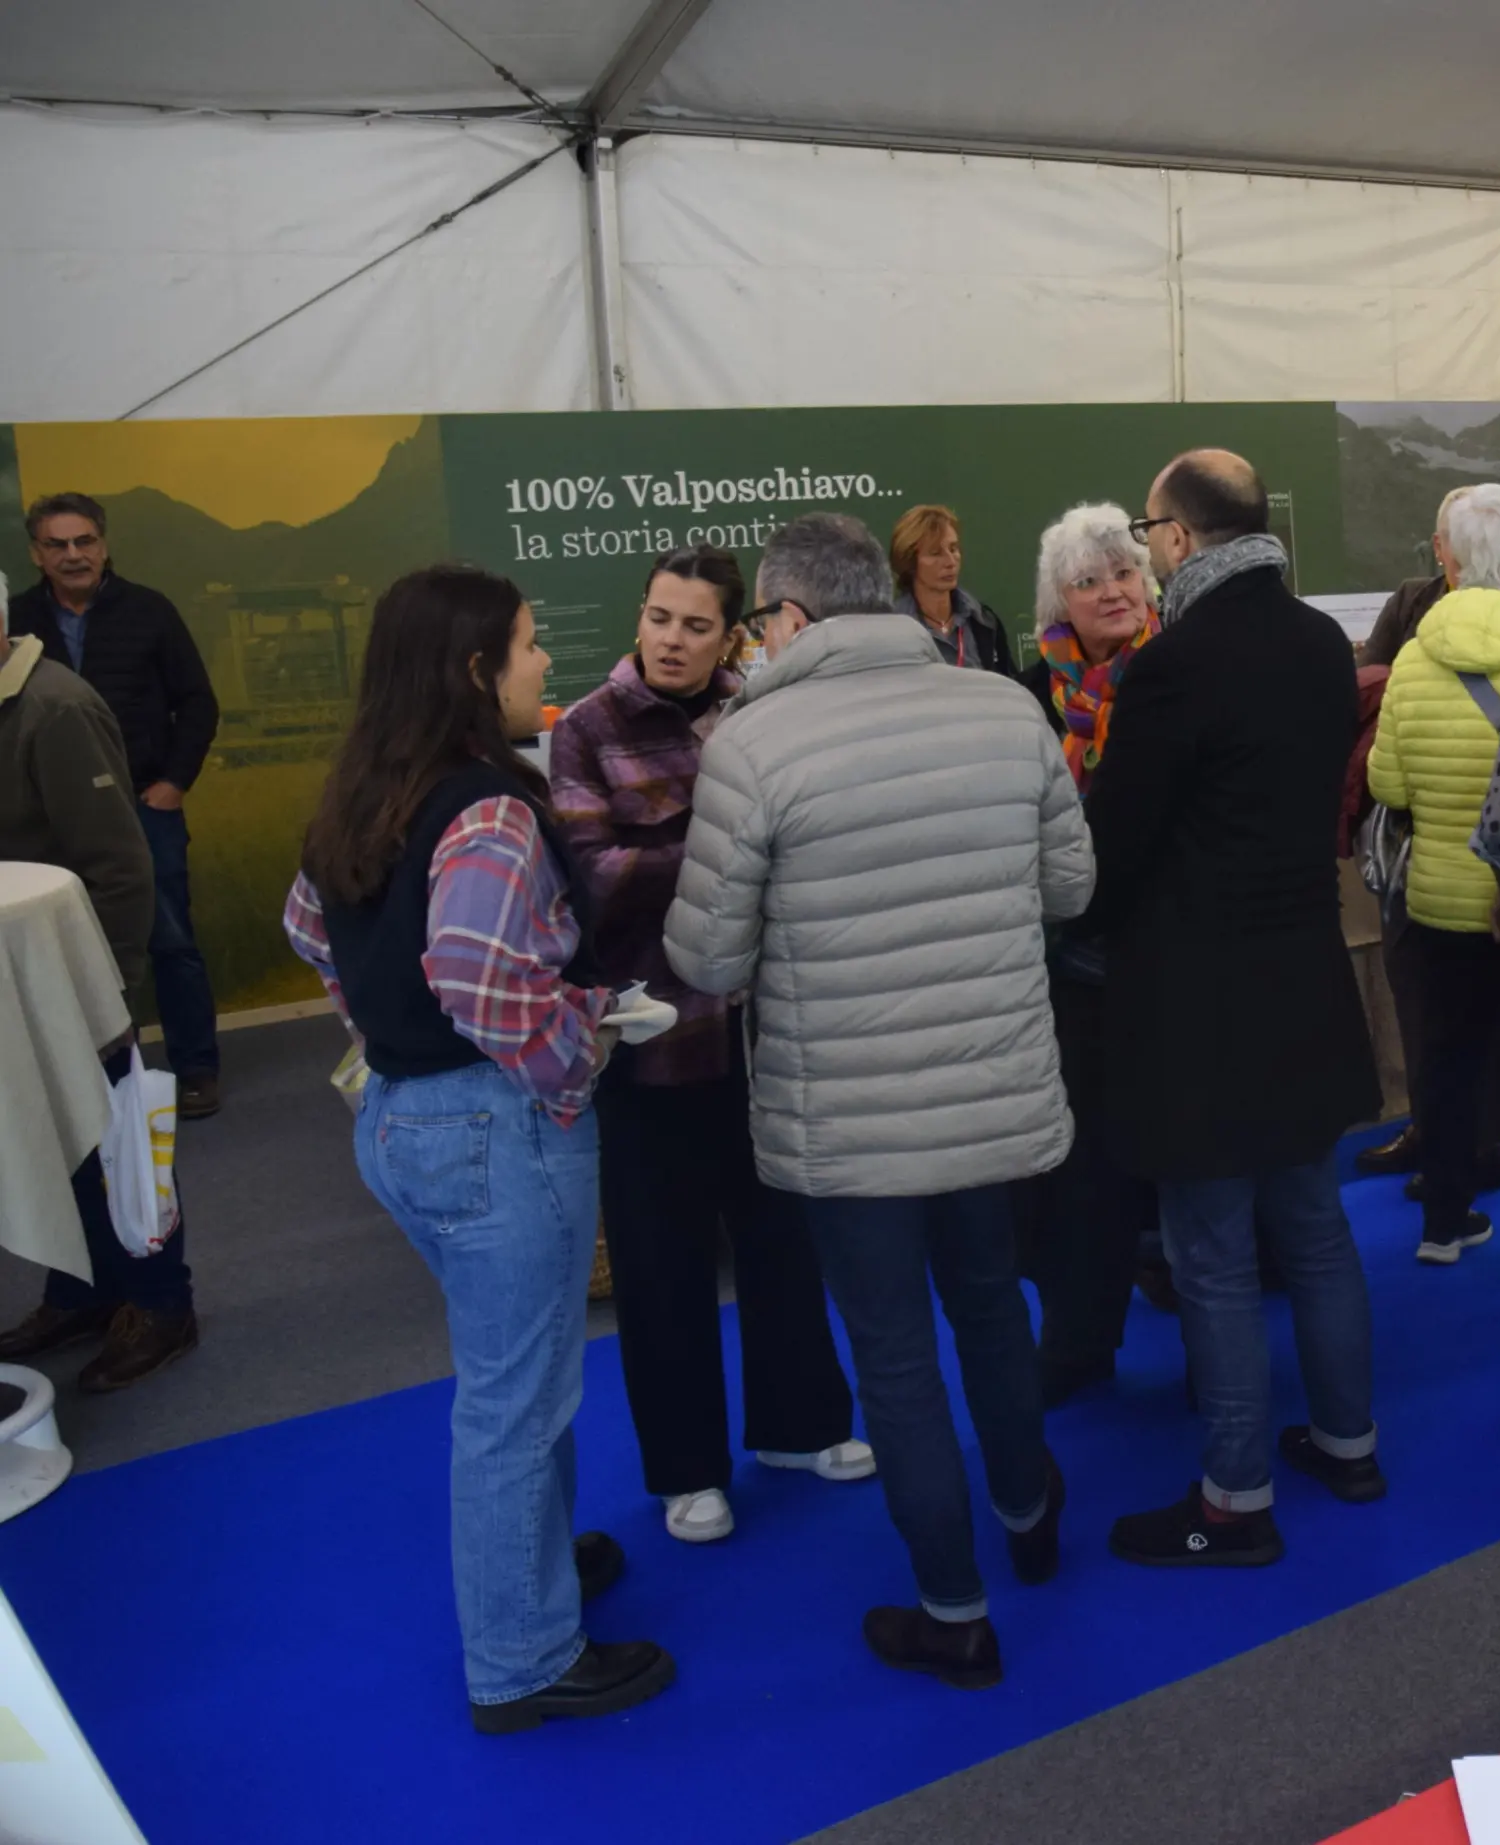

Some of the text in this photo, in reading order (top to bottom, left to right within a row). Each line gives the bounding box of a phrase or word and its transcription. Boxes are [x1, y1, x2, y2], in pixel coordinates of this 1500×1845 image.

[505, 466, 903, 513] 100% Valposchiavo...
[510, 524, 553, 561] la
[562, 519, 679, 558] storia
